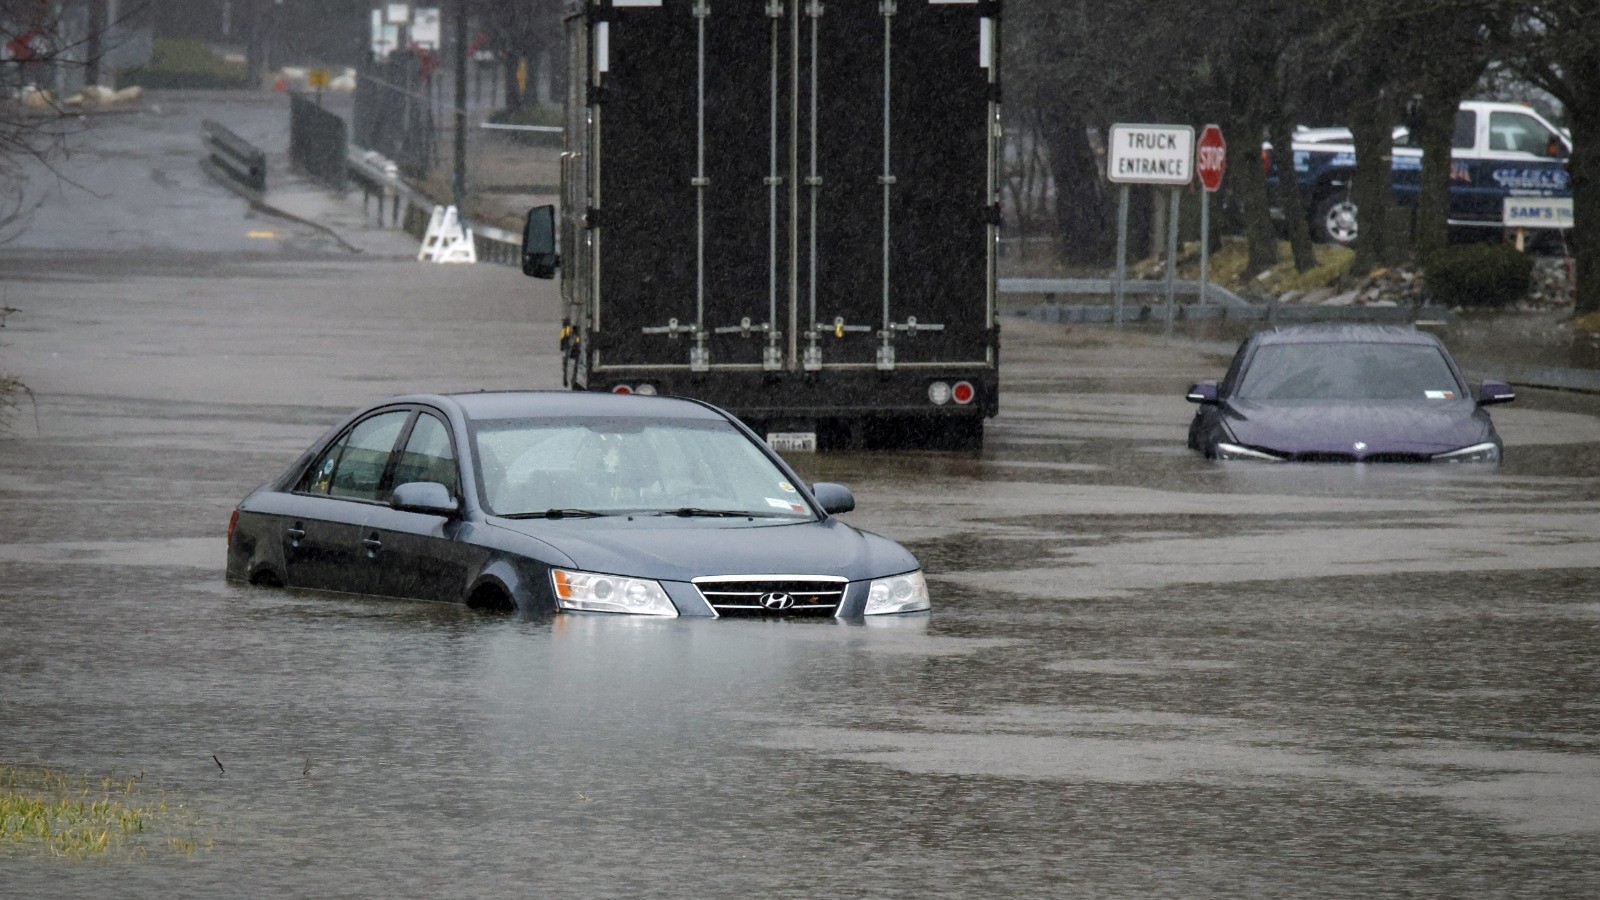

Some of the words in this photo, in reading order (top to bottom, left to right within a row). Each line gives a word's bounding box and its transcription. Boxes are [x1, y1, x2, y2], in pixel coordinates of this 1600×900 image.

[1128, 132, 1177, 150] TRUCK
[1118, 157, 1183, 176] ENTRANCE
[1199, 146, 1225, 171] STOP
[1510, 206, 1553, 219] SAM'S
